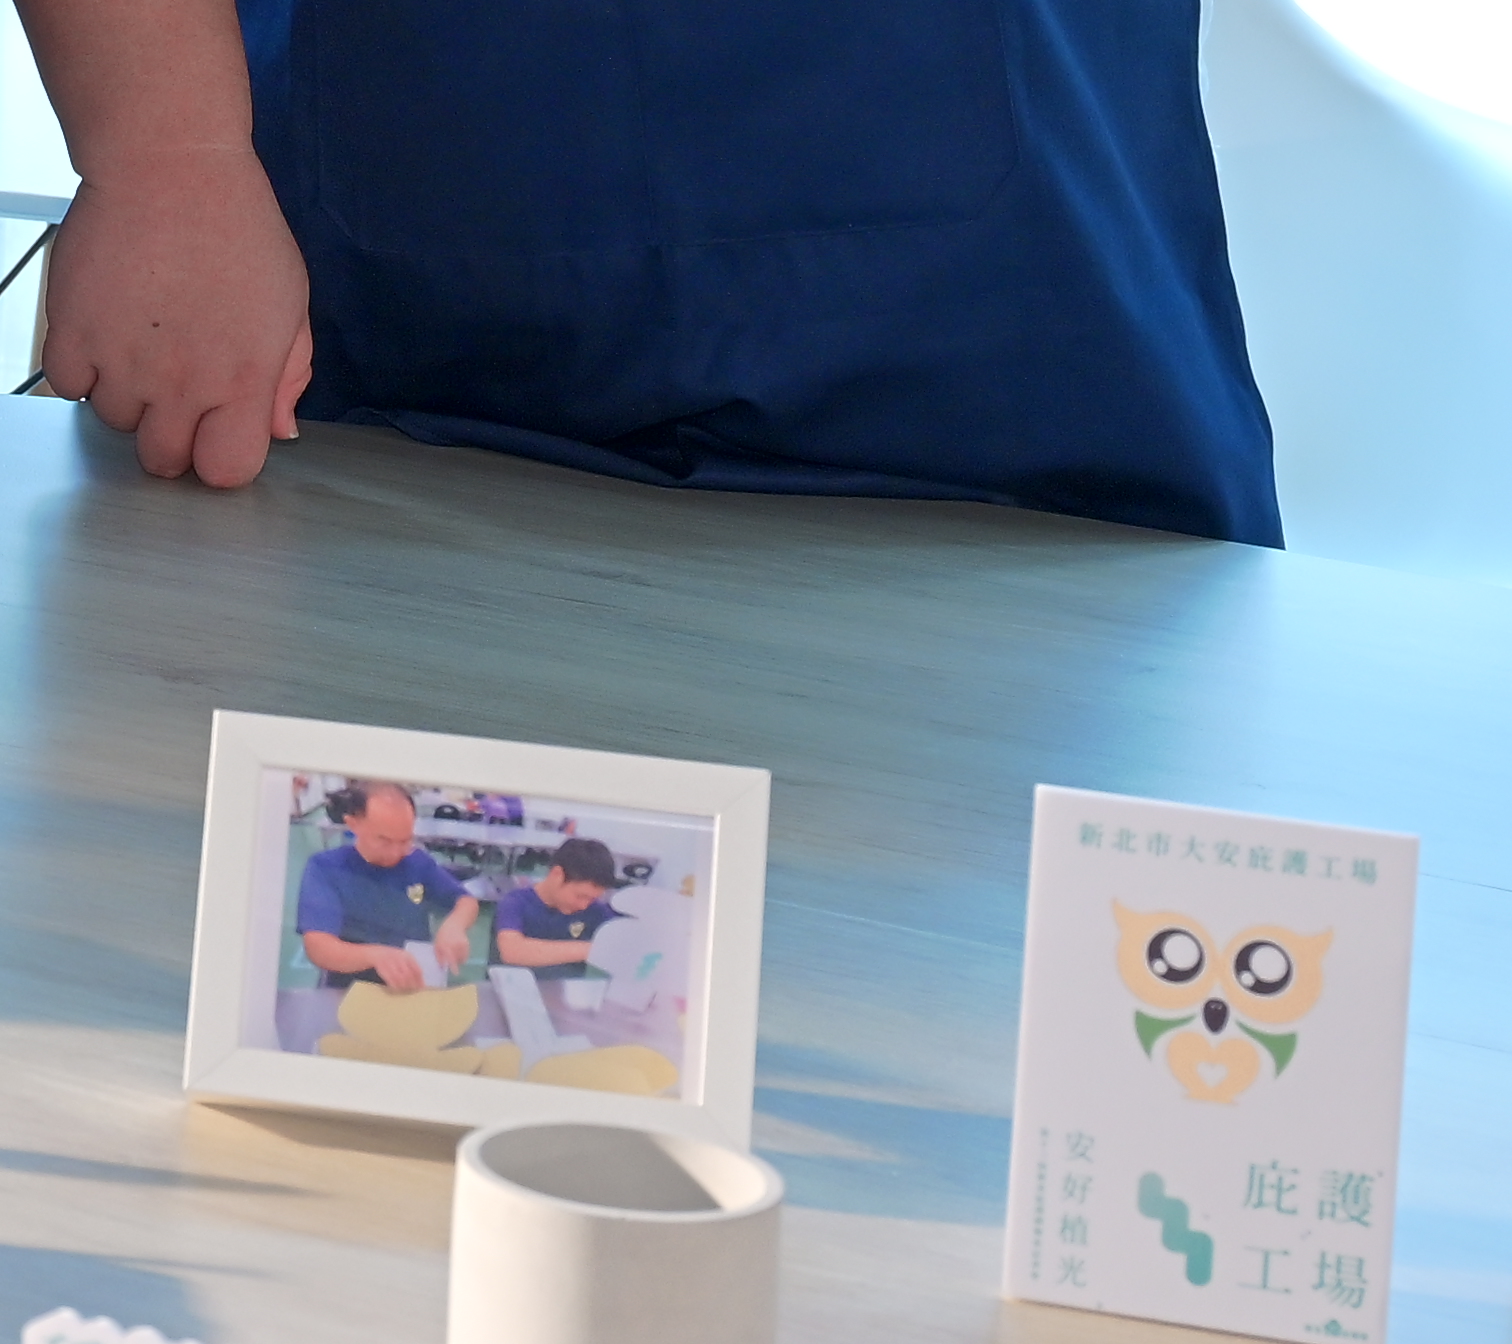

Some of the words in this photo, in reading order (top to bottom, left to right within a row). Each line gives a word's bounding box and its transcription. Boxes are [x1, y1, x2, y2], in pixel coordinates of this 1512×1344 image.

[1077, 821, 1379, 886] 新北市大安庇護工場
[1242, 1159, 1378, 1229] 庇護
[1237, 1246, 1369, 1310] 工場
